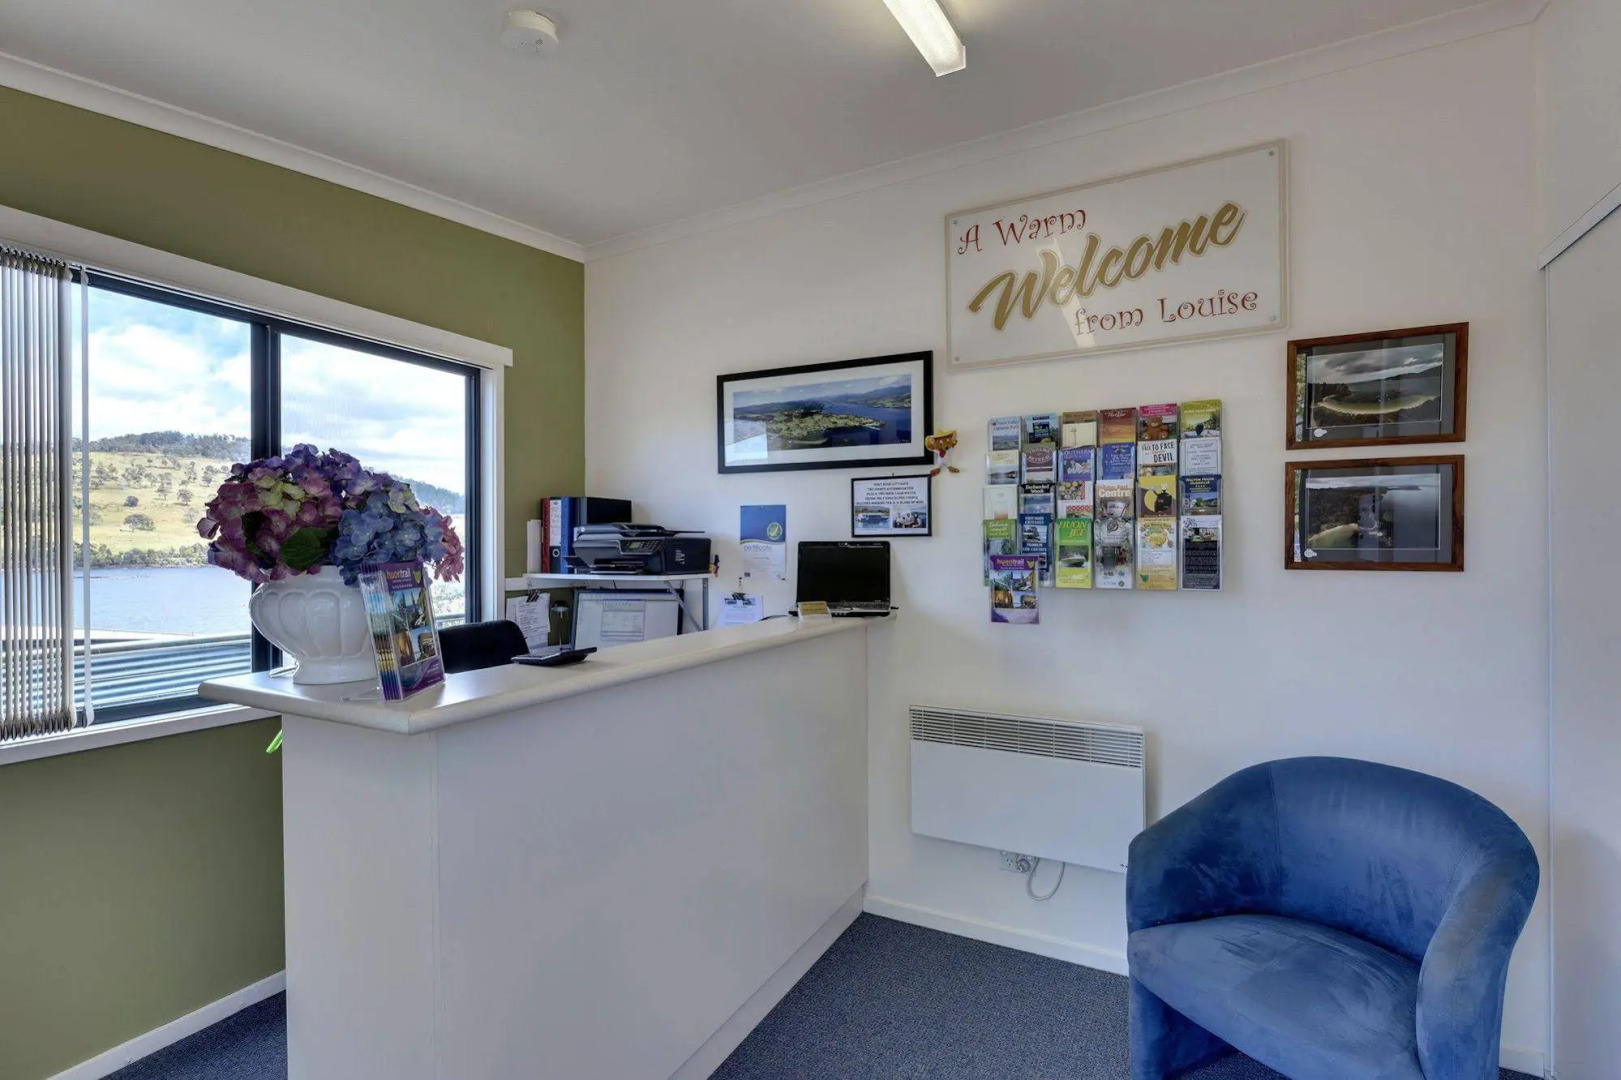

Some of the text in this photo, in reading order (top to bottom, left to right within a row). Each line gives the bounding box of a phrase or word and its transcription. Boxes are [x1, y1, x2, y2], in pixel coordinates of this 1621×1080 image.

[957, 208, 1086, 255] A Warm
[967, 201, 1247, 331] Welcome
[1073, 289, 1258, 336] from Louise
[1152, 443, 1159, 451] TO
[1159, 441, 1174, 450] FACE
[1153, 452, 1174, 463] DEVIL
[1098, 488, 1131, 498] Centre
[1059, 521, 1087, 529] HUON
[1068, 529, 1085, 538] JET
